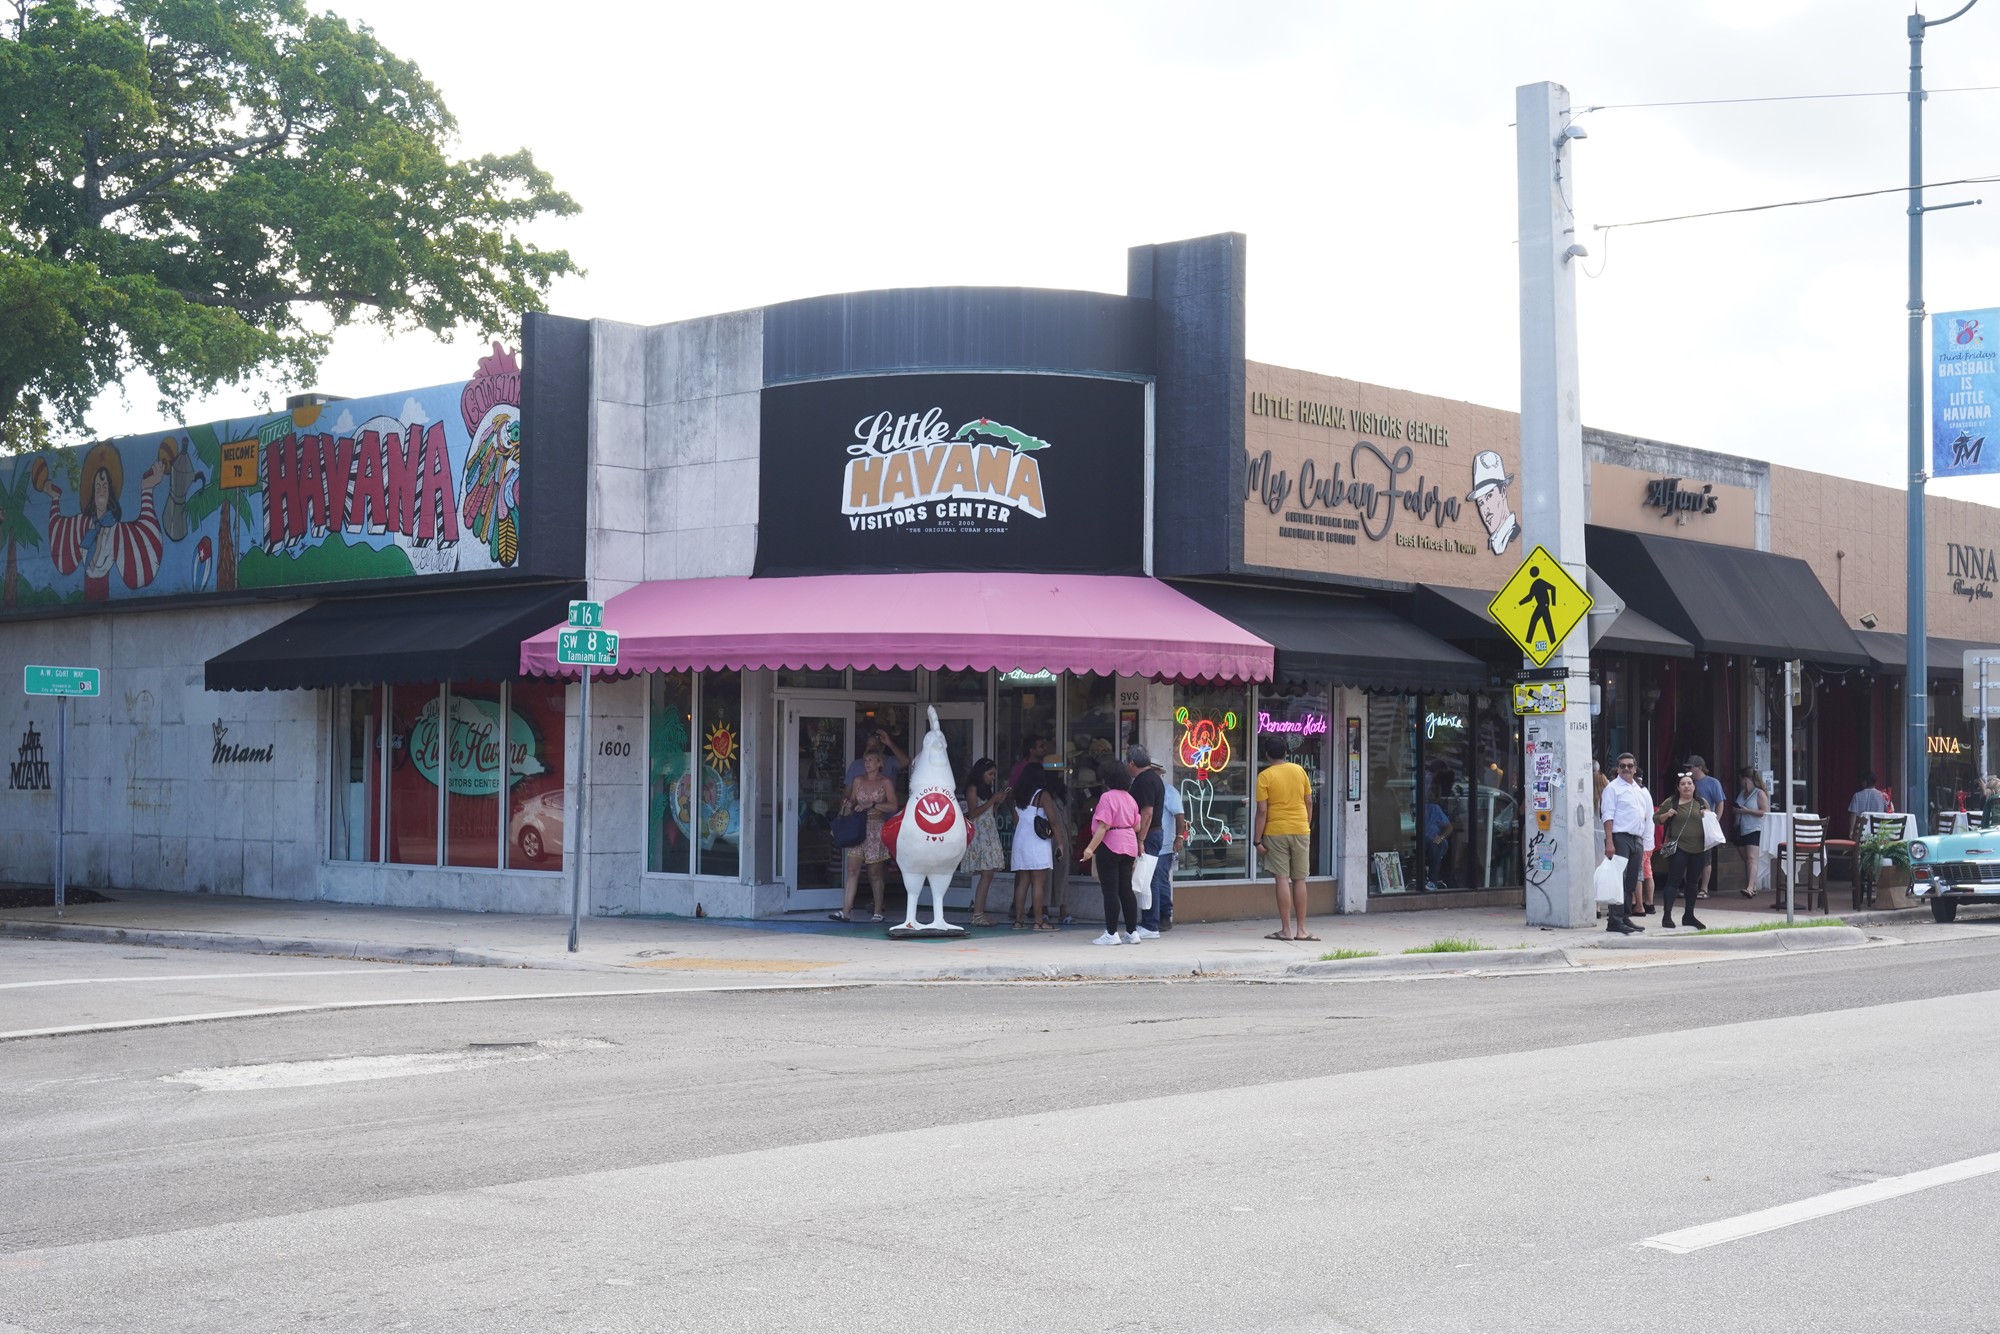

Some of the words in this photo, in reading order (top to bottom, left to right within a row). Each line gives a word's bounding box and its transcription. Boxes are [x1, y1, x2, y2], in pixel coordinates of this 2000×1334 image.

[1939, 352, 1963, 362] Third
[1964, 350, 1997, 361] Fridays
[1939, 361, 1995, 377] BASEBALL
[1961, 376, 1973, 390] IS
[1950, 390, 1984, 406] LITTLE
[1252, 391, 1294, 421] LITTLE
[1299, 400, 1346, 430] HAVANA
[1350, 409, 1402, 439] VISITORS
[1406, 419, 1449, 447] CENTER
[1943, 405, 1992, 421] HAVANA
[846, 406, 950, 457] Little
[224, 445, 255, 461] WELCOME
[233, 464, 243, 478] TO
[262, 420, 459, 555] HAVANA
[841, 442, 1047, 519] HAVANA
[1245, 448, 1293, 514] My
[1299, 458, 1378, 520] Cuban
[1351, 440, 1461, 541] Fedora
[849, 505, 928, 531] VISITORS
[936, 502, 1011, 523] CENTER
[1315, 514, 1342, 528] PANAMA
[1343, 518, 1360, 530] HATS
[1317, 530, 1325, 541] IN
[1396, 532, 1417, 547] Best
[1418, 535, 1444, 551] Prices
[1445, 538, 1454, 552] in
[1455, 539, 1477, 554] Town
[1947, 542, 1999, 582] INNA
[569, 609, 578, 623] SW
[582, 605, 593, 626] 16
[563, 634, 578, 649] SW
[587, 631, 597, 651] 8
[605, 637, 615, 651] ST
[567, 650, 596, 662] Tamiami
[73, 670, 85, 679] WAY
[1120, 692, 1139, 701] SVG
[1257, 711, 1303, 734] Panama
[1303, 713, 1328, 737] Hats
[21, 731, 41, 749] LOVE
[598, 741, 631, 757] 1600
[1927, 736, 1960, 754] NNA
[18, 746, 43, 765] YOU
[212, 741, 274, 764] Miami
[9, 762, 51, 790] MIAMI
[920, 786, 938, 796] LOVE
